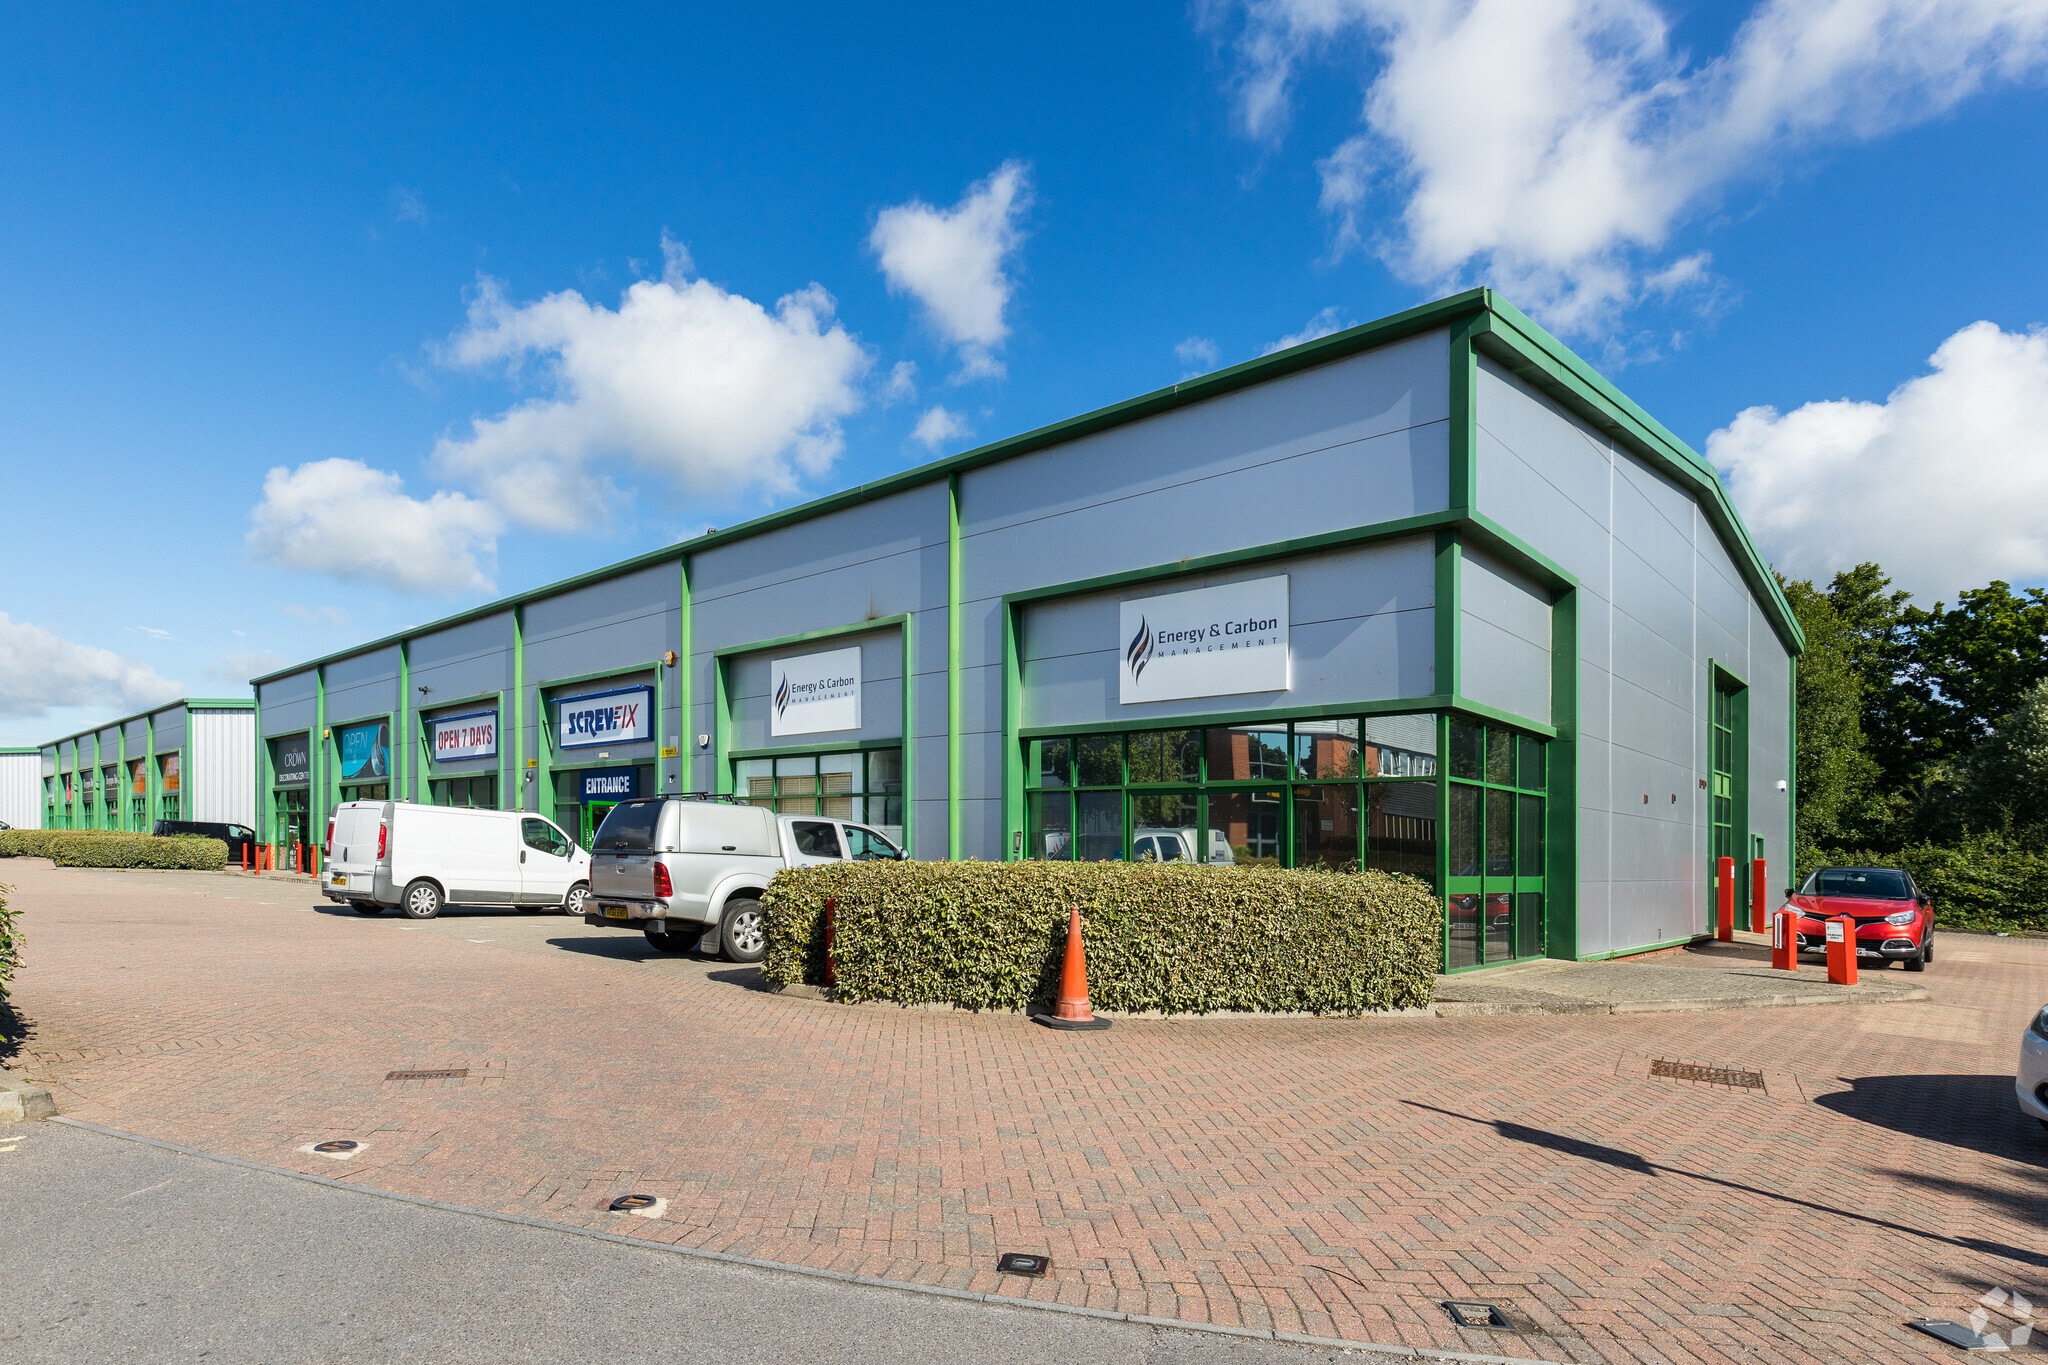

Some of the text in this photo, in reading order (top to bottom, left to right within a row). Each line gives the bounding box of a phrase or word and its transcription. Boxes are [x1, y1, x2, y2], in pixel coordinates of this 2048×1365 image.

[1158, 617, 1278, 644] Energy & Carbon
[1158, 637, 1278, 658] MANAGEMENT
[792, 676, 855, 694] Energy & Carbon
[791, 690, 855, 704] MANAGEMENT
[568, 703, 639, 738] SCREWFIX
[438, 724, 493, 751] OPEN 7 DAYS
[284, 751, 306, 767] CROWN
[586, 776, 630, 795] ENTRANCE
